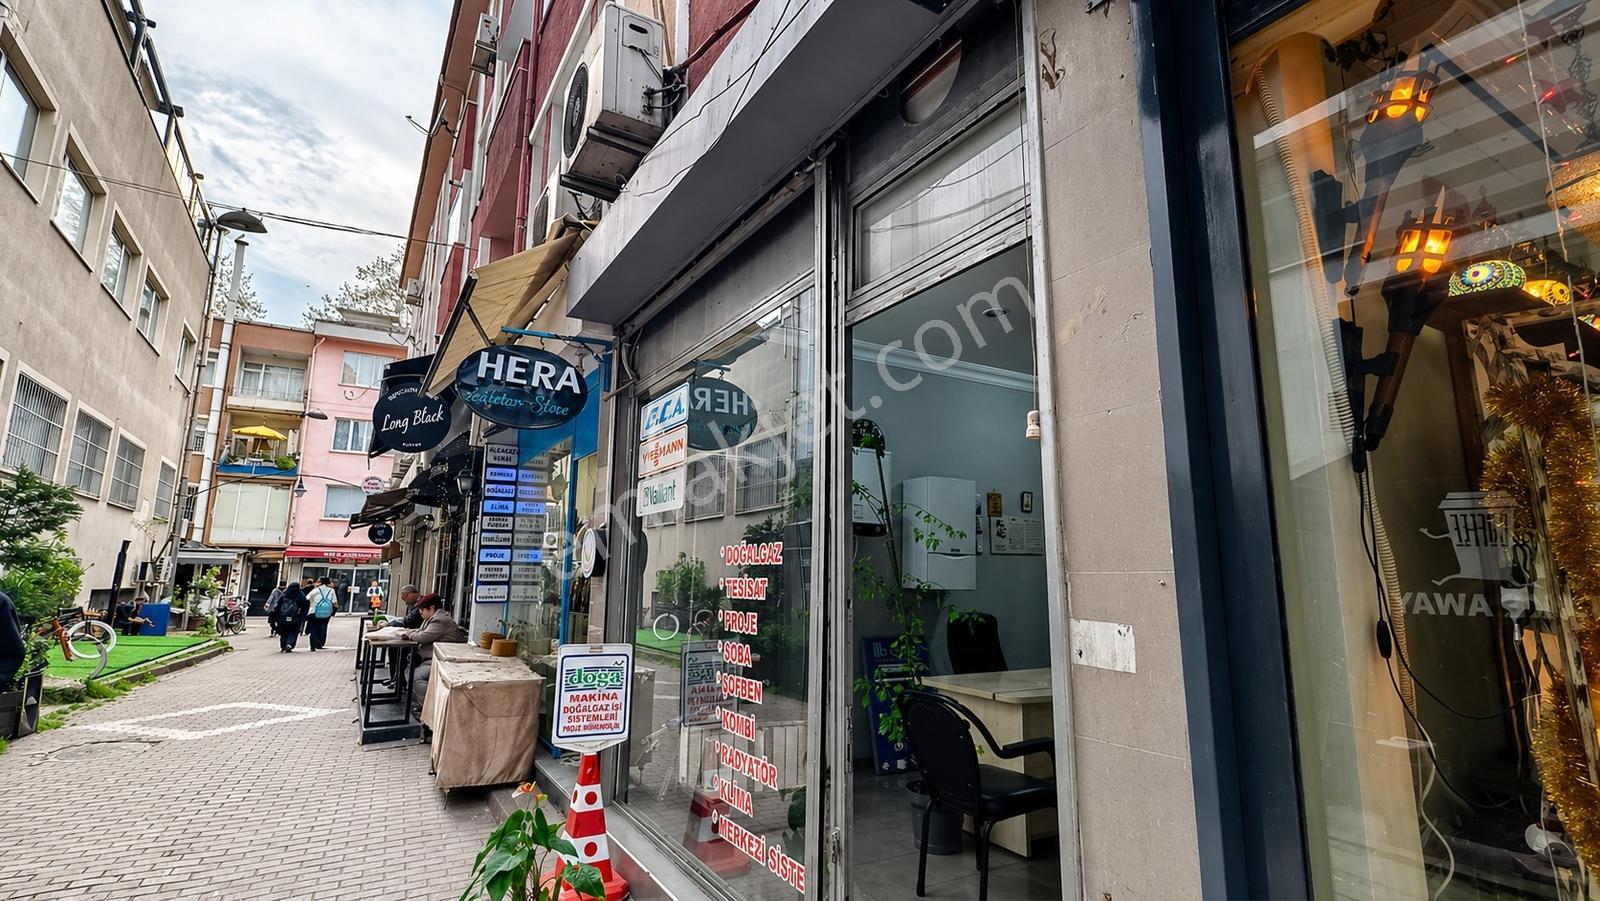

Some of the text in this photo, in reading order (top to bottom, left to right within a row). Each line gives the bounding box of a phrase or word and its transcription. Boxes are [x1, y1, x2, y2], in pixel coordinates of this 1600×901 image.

[478, 351, 581, 394] HERA
[381, 414, 409, 434] Long
[649, 480, 676, 505] Vaillant
[725, 541, 783, 565] DOĞALGAZ
[725, 574, 768, 600] TESİSAT
[724, 611, 758, 635] PROJE
[723, 641, 752, 667] SOBA
[721, 708, 756, 742] KOMBİ
[719, 777, 753, 818] KLİMA
[719, 814, 766, 867] MERKEZİ
